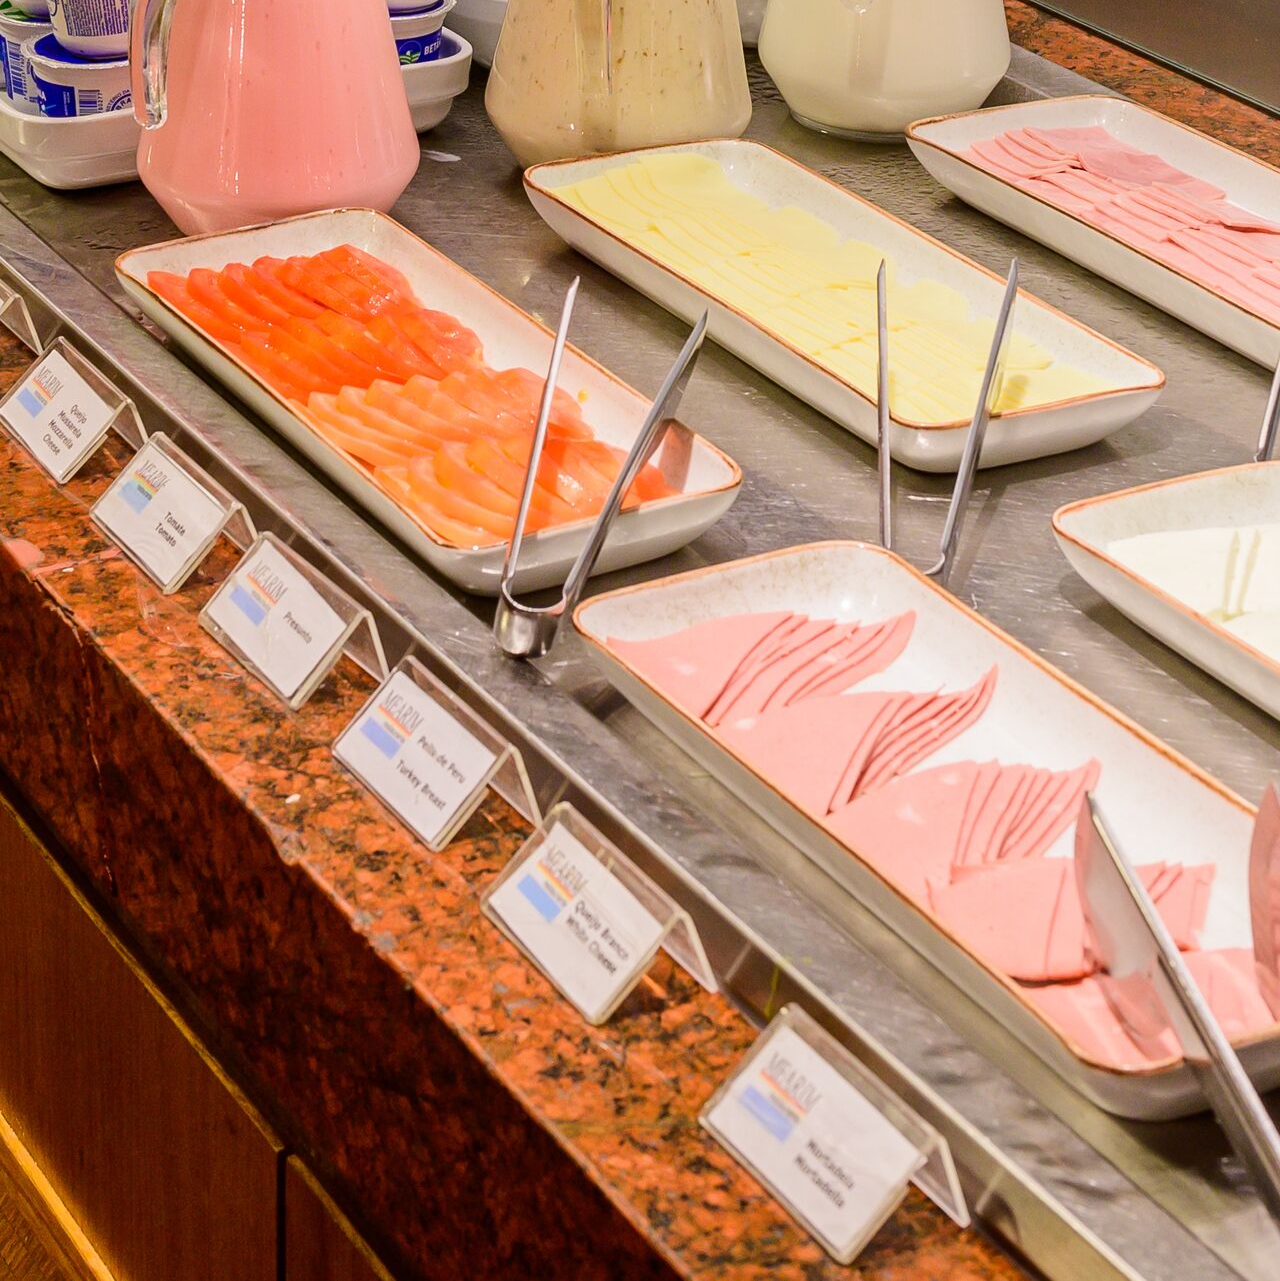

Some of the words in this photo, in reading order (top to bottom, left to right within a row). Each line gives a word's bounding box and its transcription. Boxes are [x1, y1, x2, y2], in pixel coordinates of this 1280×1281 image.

[115, 97, 132, 112] BRA
[57, 410, 82, 438] Mussarela
[69, 403, 88, 425] Queijo
[42, 433, 61, 455] Cheese
[47, 419, 74, 448] Mozzarella
[155, 522, 178, 547] Tomato
[163, 512, 187, 536] Tomate
[283, 611, 314, 645] Presunto
[417, 735, 438, 757] Peito
[435, 753, 448, 767] de
[446, 762, 467, 784] Peru
[394, 759, 422, 787] Turkey
[420, 783, 446, 810] Breast
[574, 900, 602, 932] Queijo
[601, 927, 630, 961] Branco
[565, 914, 589, 943] White
[587, 940, 618, 976] Cheese
